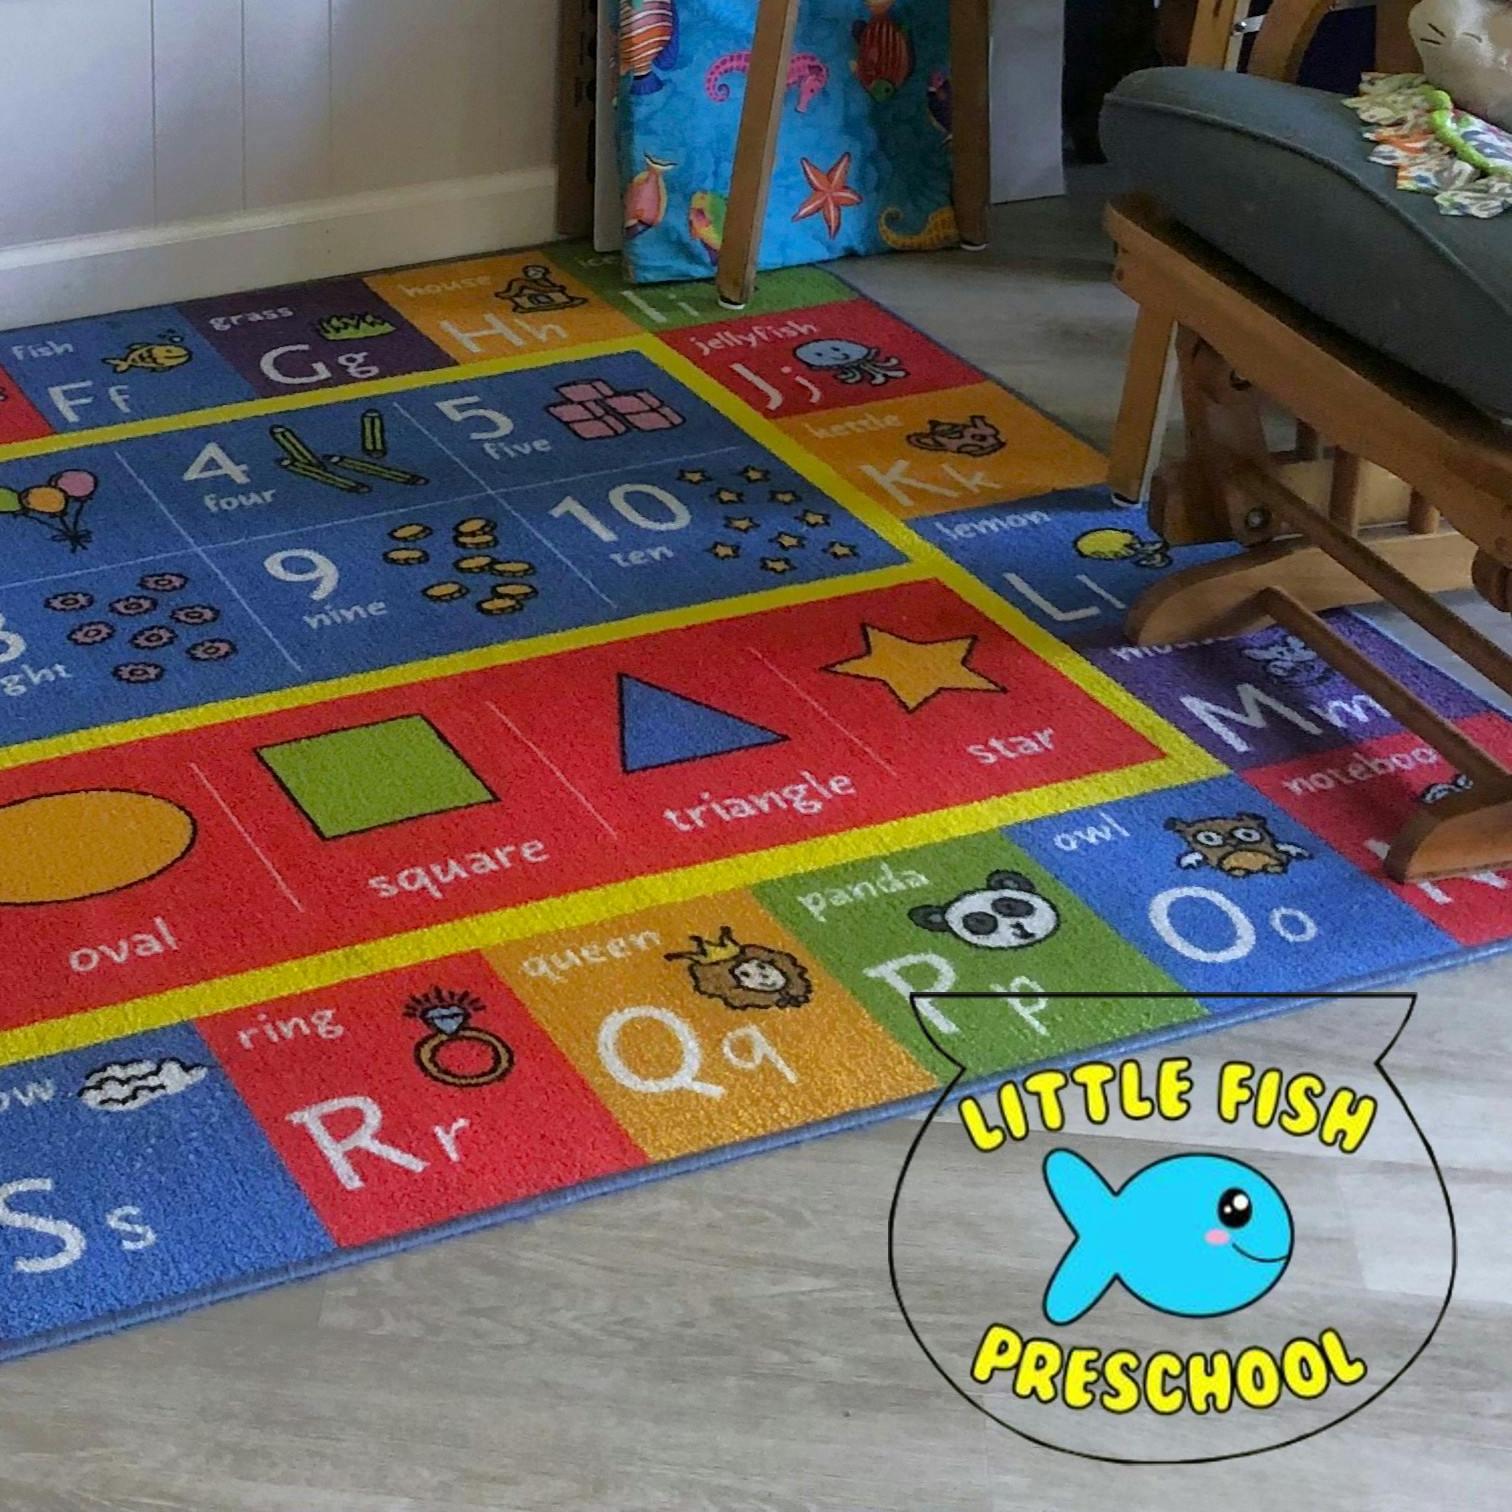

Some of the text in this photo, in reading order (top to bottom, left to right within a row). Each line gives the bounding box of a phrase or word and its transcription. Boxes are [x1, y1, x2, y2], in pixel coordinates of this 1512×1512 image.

[208, 303, 294, 332] grass
[688, 317, 818, 358] jellyfish
[435, 394, 515, 443] 5
[182, 441, 250, 486] 4
[483, 434, 552, 461] five
[204, 485, 277, 513] four
[550, 483, 689, 543] 10
[940, 504, 1051, 541] lemon
[262, 548, 340, 602] 9
[610, 543, 674, 568] ten
[303, 596, 388, 631] nine
[966, 726, 1059, 767] star
[663, 769, 857, 836] triangle
[1053, 813, 1129, 854] owl
[367, 837, 551, 900] square
[797, 862, 930, 923] panda
[68, 916, 178, 975] oval
[519, 924, 662, 982] queen
[236, 1006, 345, 1052] ring
